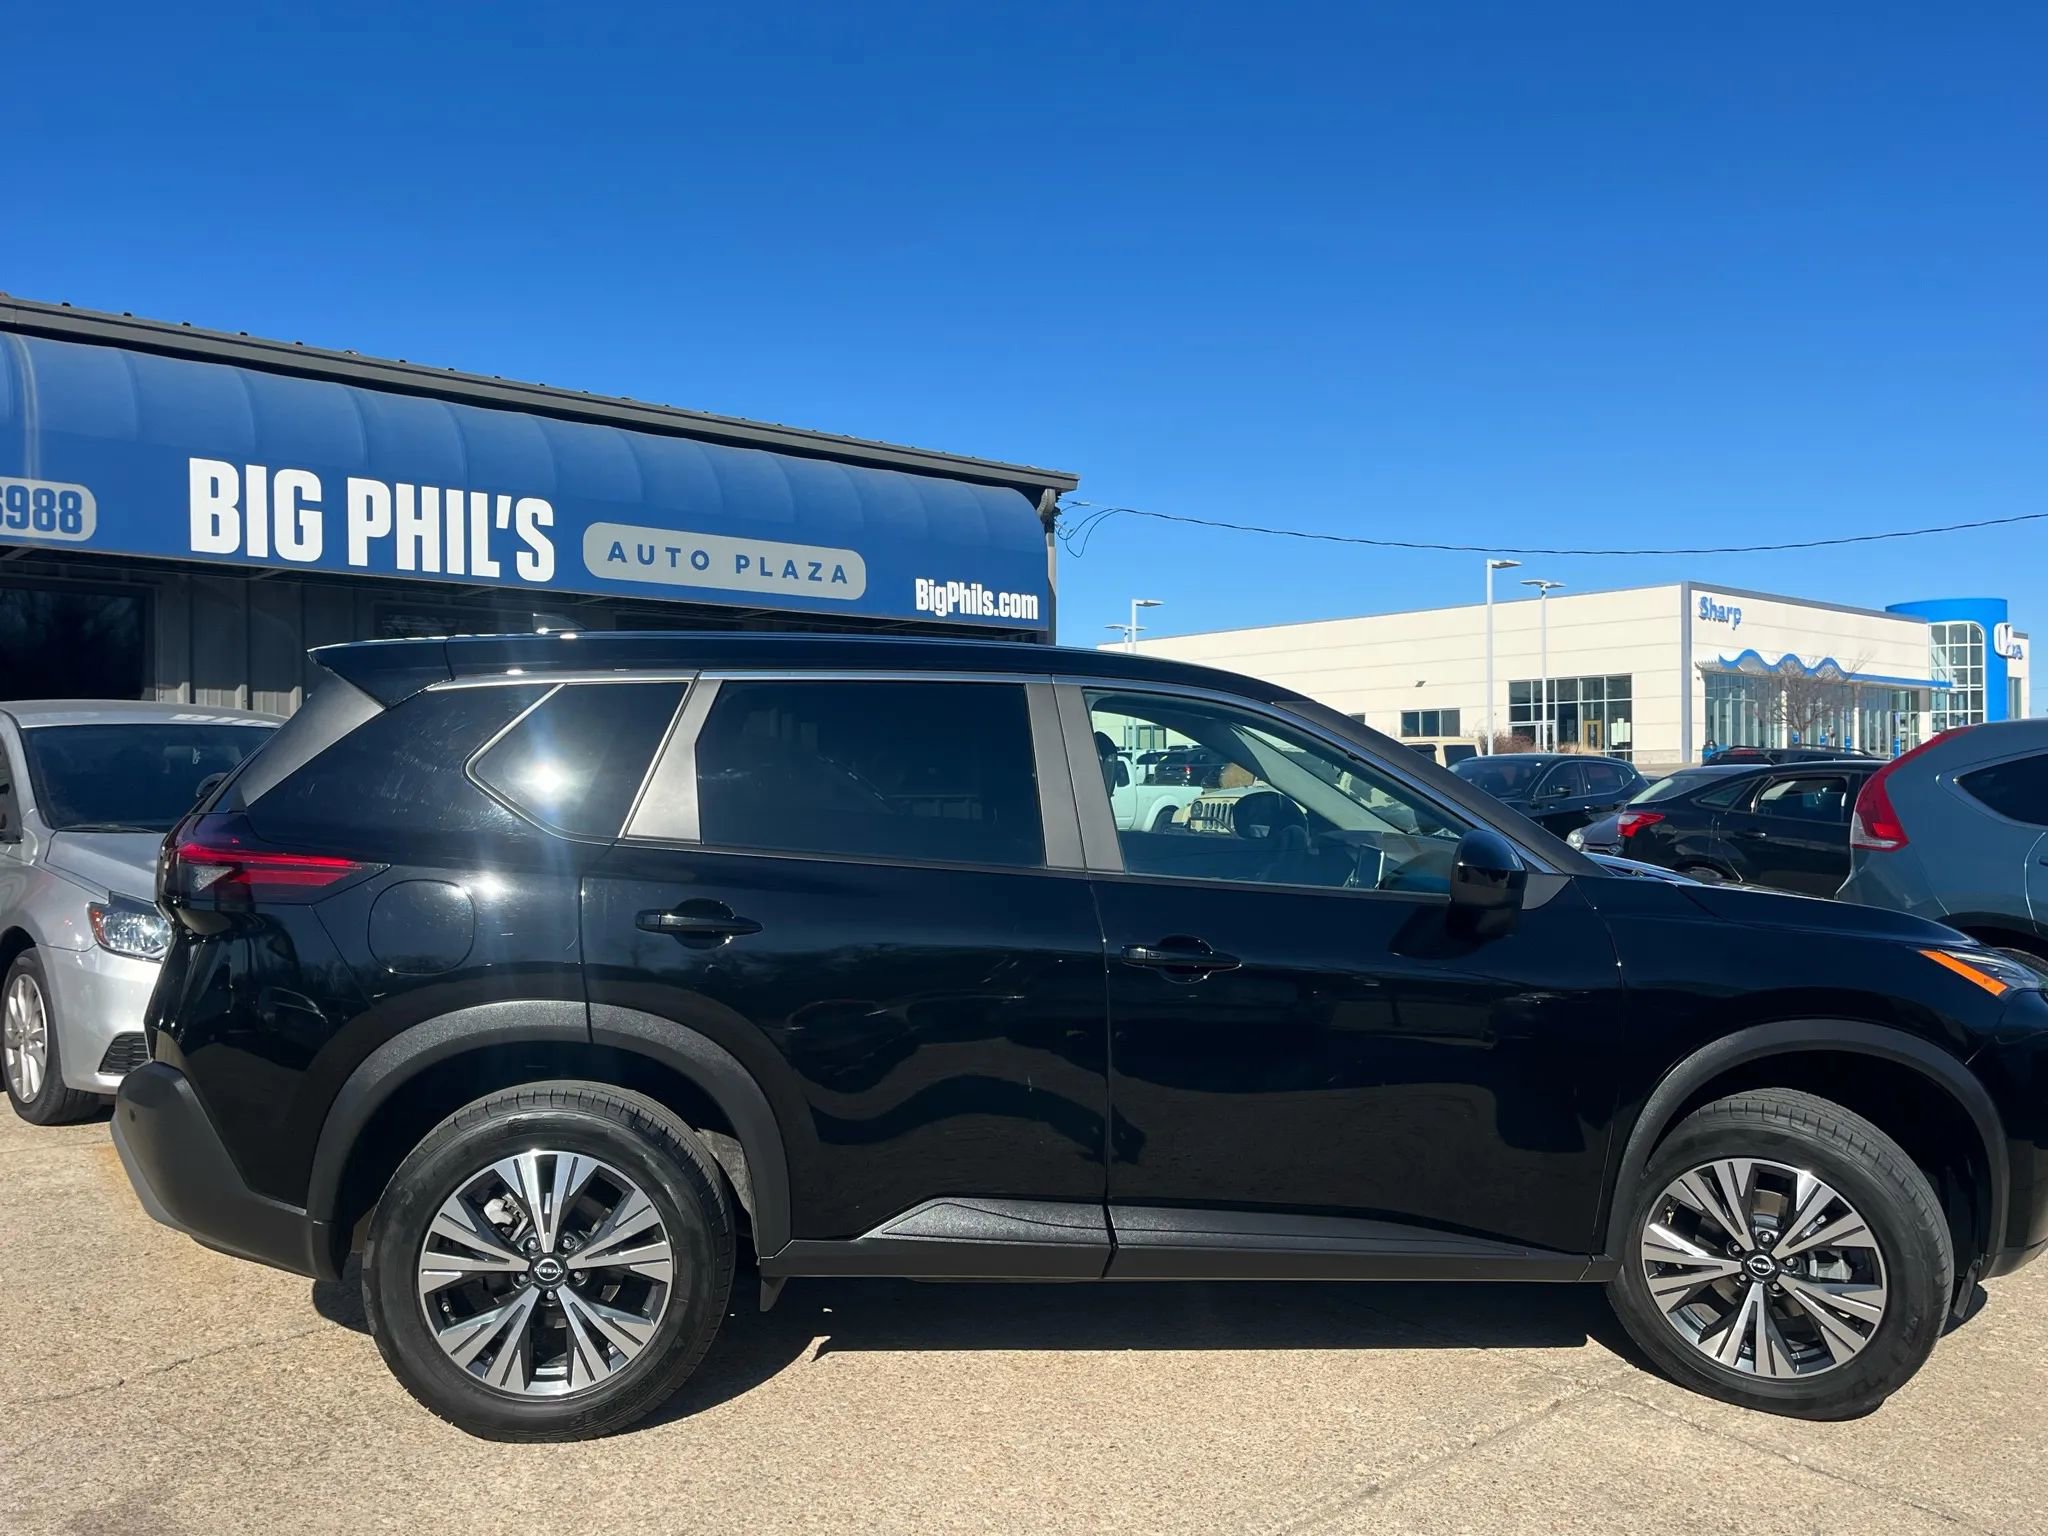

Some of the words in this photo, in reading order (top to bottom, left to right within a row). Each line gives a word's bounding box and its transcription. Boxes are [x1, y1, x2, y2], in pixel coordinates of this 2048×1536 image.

[0, 485, 82, 534] 988
[189, 457, 323, 562] BIG
[347, 477, 554, 582] PHIL'S
[607, 541, 710, 571] AUTO
[735, 555, 848, 584] PLAZA
[915, 578, 1038, 619] BigPhils.com
[1699, 596, 1742, 630] Sharp
